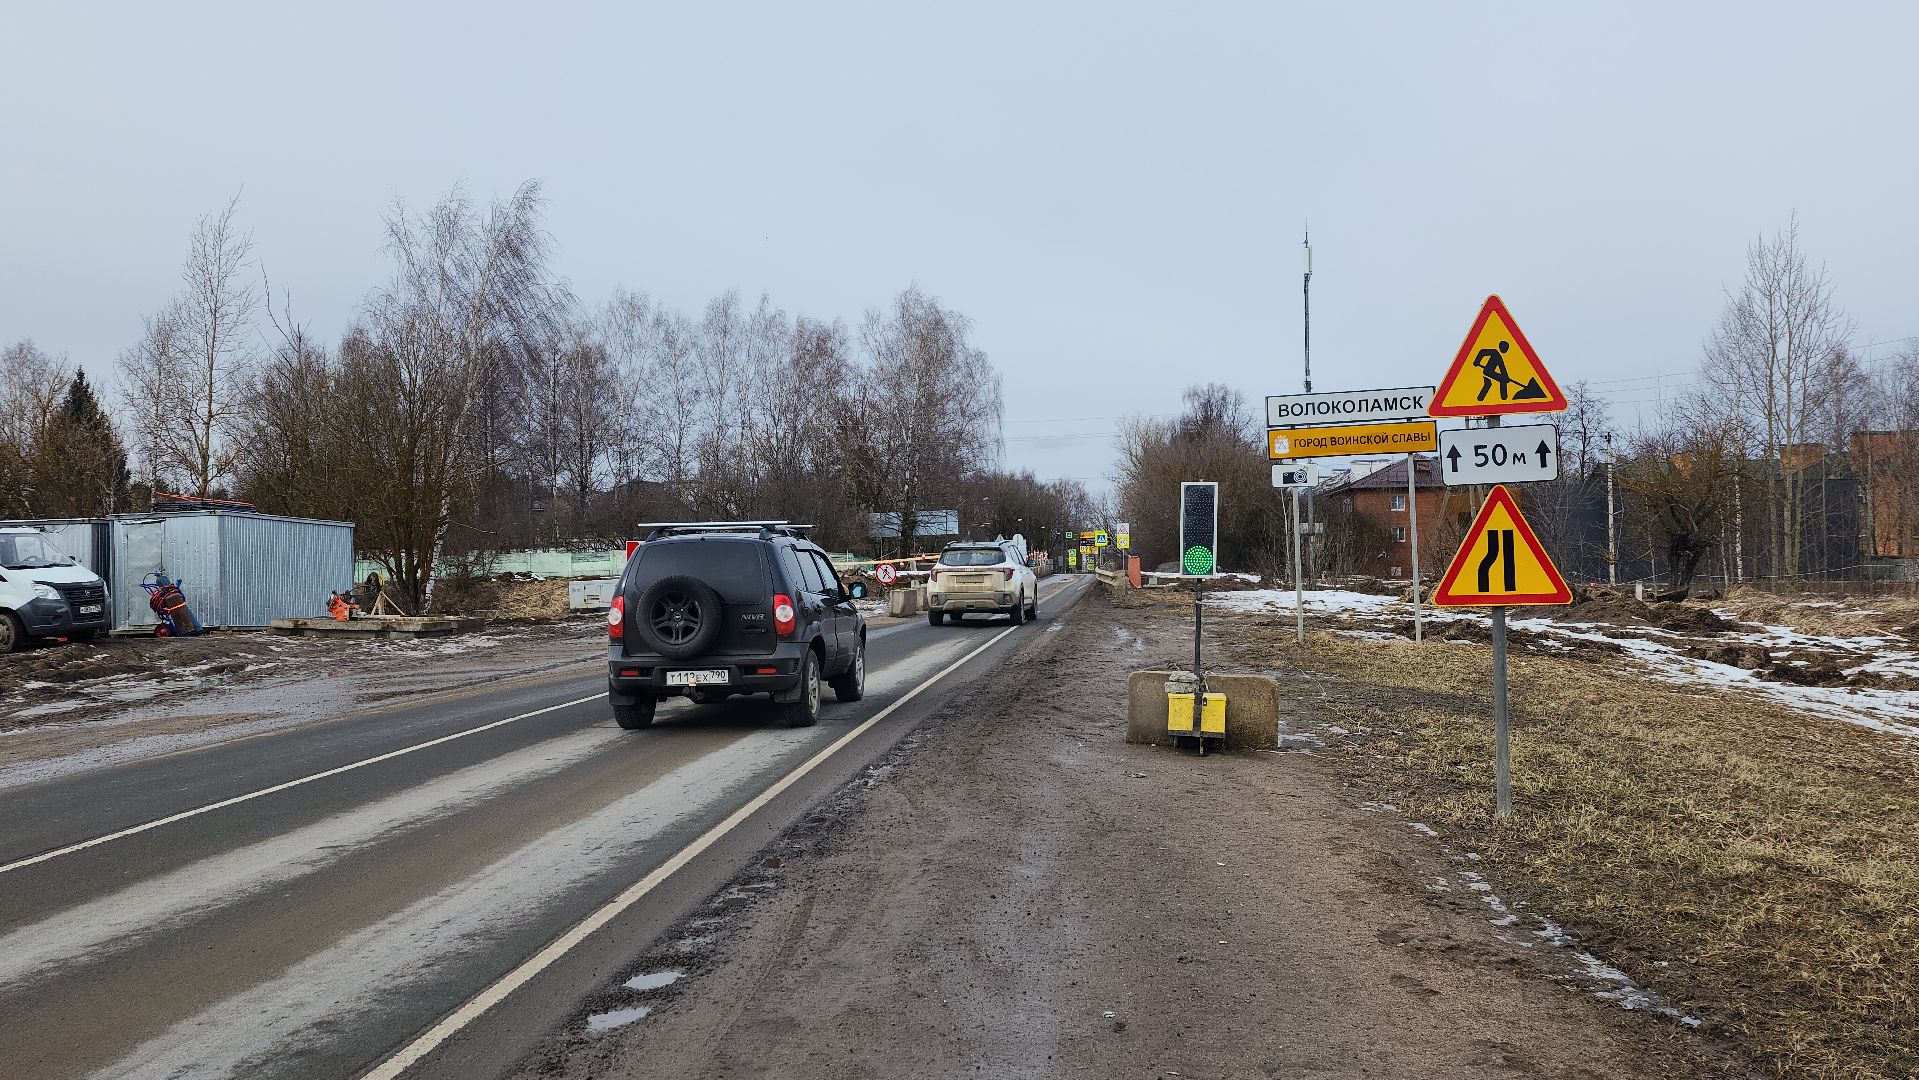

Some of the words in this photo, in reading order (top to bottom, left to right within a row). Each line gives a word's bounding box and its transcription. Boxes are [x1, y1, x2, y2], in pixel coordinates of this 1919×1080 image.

[1278, 395, 1424, 418] ВОЛОКОЛАМСК
[1294, 437, 1328, 449] ГОРОД
[1330, 432, 1389, 446] ВОИНСКОЙ
[1391, 431, 1431, 443] СЛАВЫ
[1474, 443, 1508, 468] 50
